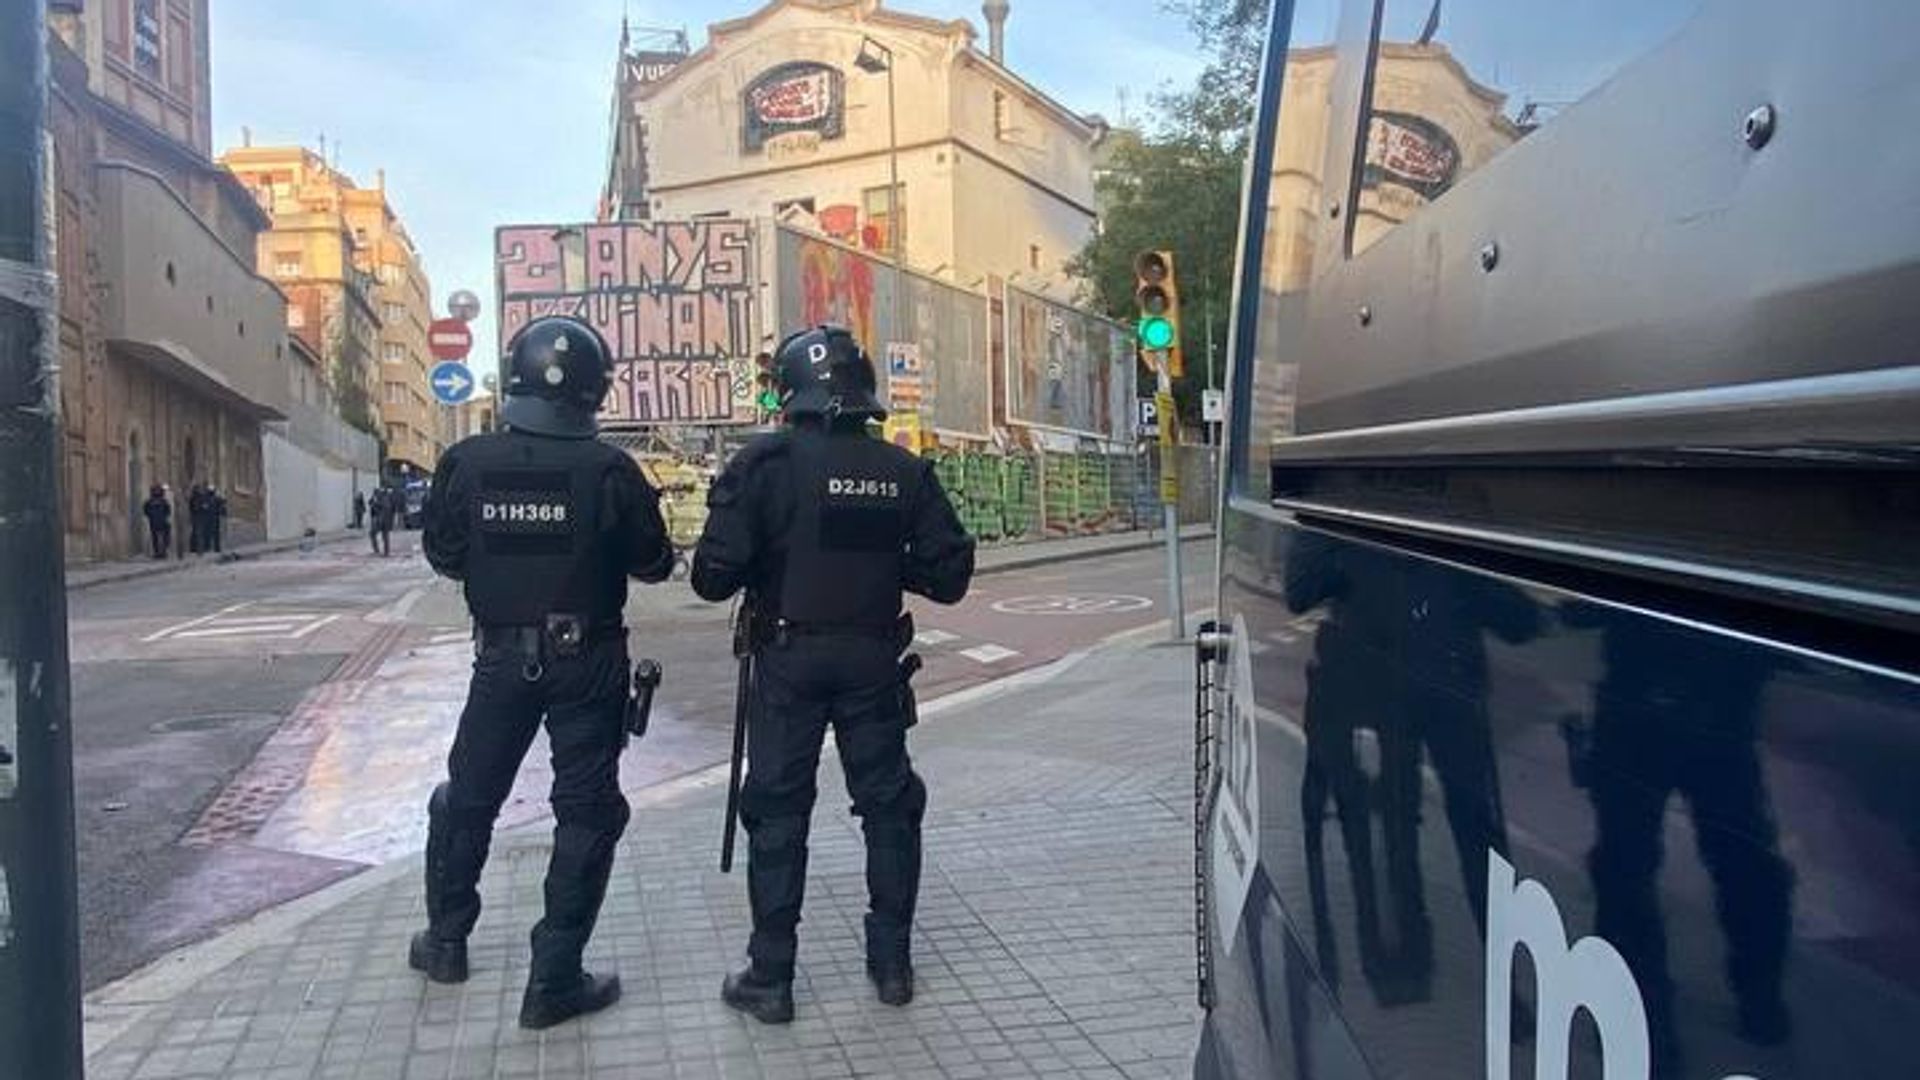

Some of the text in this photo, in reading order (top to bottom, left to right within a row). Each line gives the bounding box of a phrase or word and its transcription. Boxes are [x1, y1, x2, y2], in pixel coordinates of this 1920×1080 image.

[584, 222, 749, 289] ANYS
[808, 344, 827, 364] D
[1142, 402, 1157, 423] P
[482, 503, 566, 521] D1H368
[1486, 847, 1765, 1080] m
